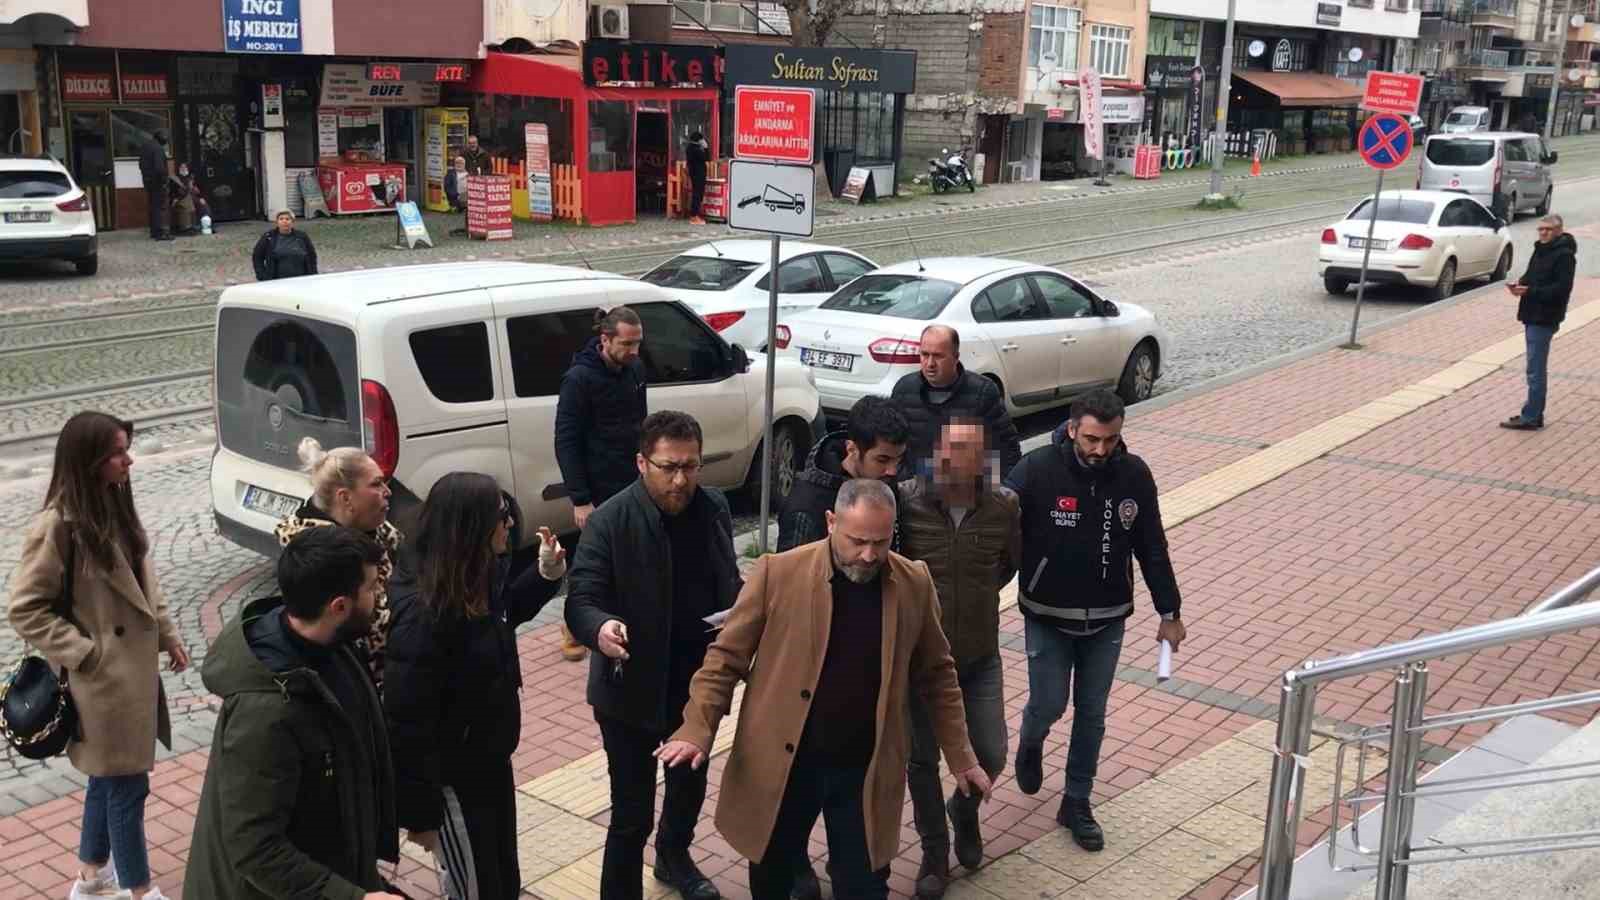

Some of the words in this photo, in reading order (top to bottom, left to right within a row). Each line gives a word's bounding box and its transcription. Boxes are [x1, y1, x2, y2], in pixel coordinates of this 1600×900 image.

[228, 15, 241, 42] İŞ
[243, 18, 299, 39] MERKEZİ
[592, 48, 725, 83] etiket
[771, 52, 825, 80] Sultan
[828, 56, 880, 88] Sofrası
[64, 76, 111, 97] DİLEKÇE
[753, 98, 785, 113] EMNİYET
[786, 103, 795, 112] ve
[753, 117, 794, 132] JANDARMA
[738, 132, 784, 149] ARAÇLARINA
[806, 350, 815, 364] 34
[831, 353, 852, 368] 3971
